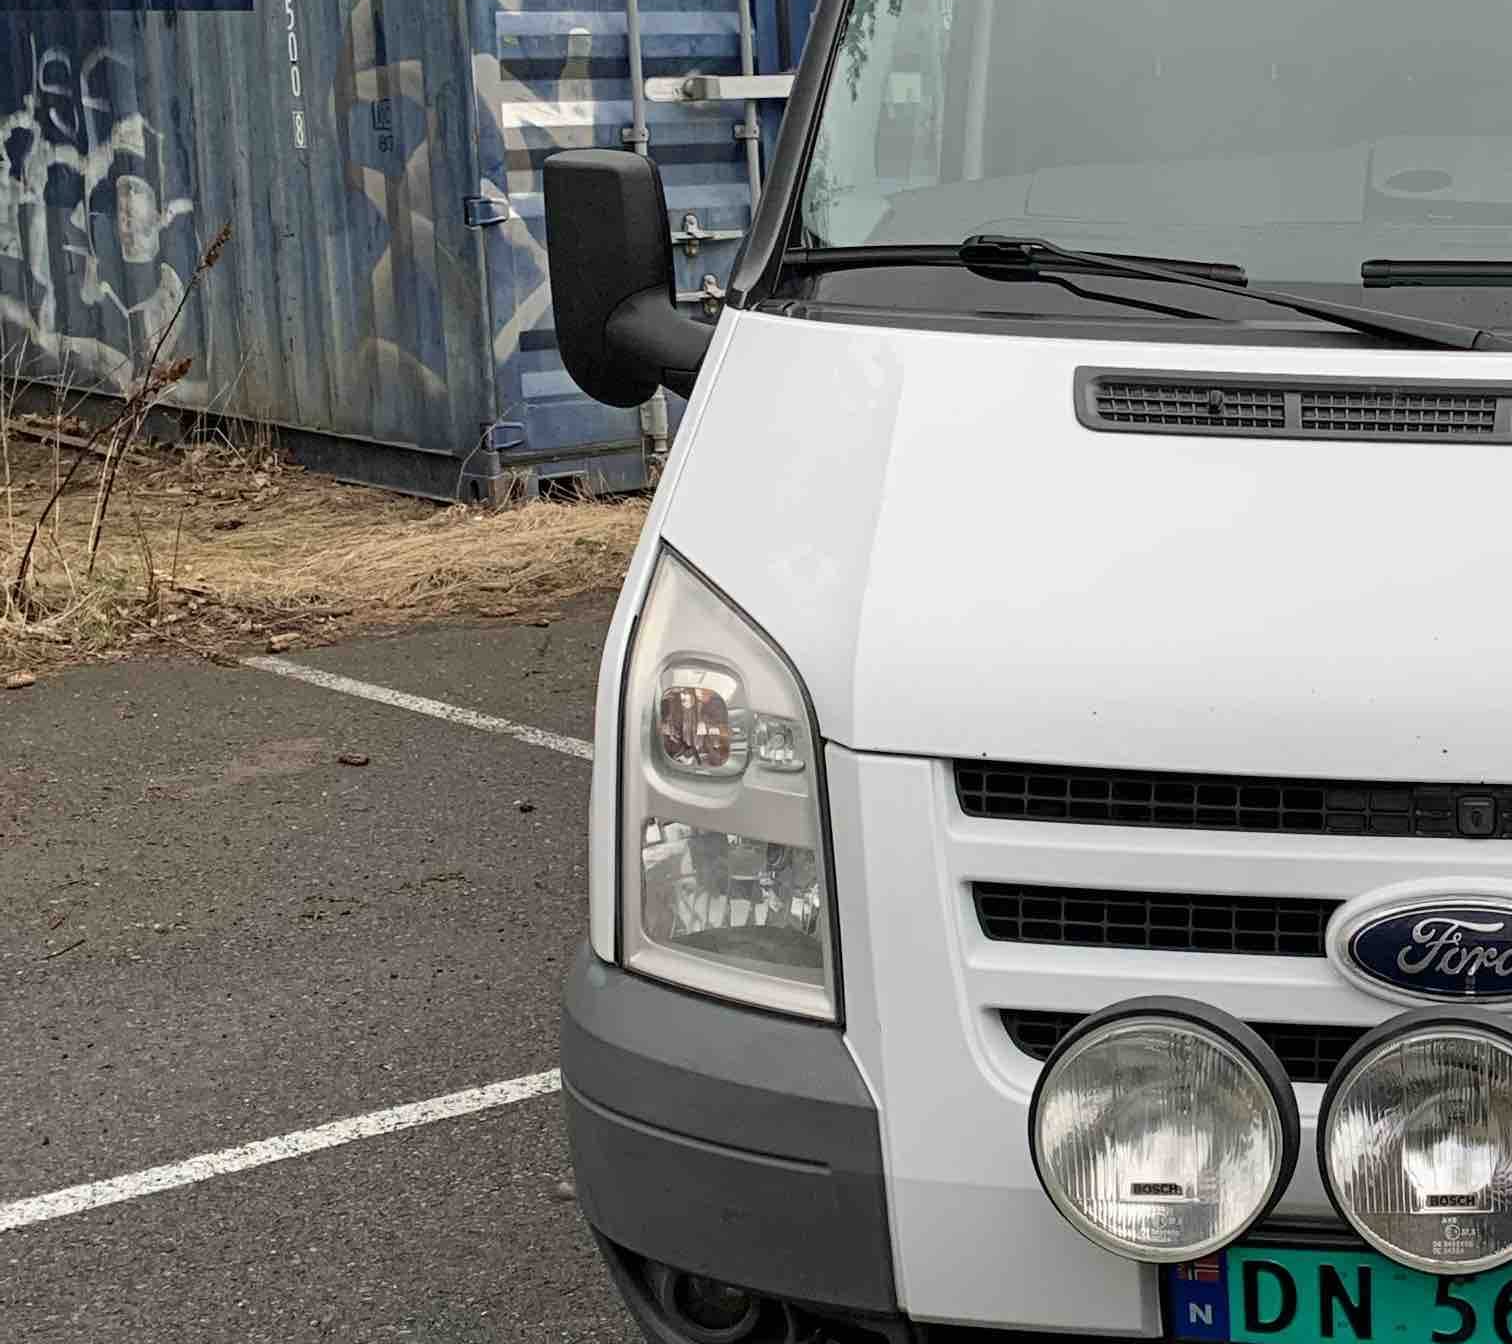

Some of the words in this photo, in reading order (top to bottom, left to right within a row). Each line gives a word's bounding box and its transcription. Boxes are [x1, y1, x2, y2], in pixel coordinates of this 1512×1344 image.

[1133, 1183, 1180, 1195] BOSCH
[1429, 1196, 1475, 1207] BOSCH
[1242, 1258, 1374, 1340] DN
[1188, 1302, 1213, 1325] N
